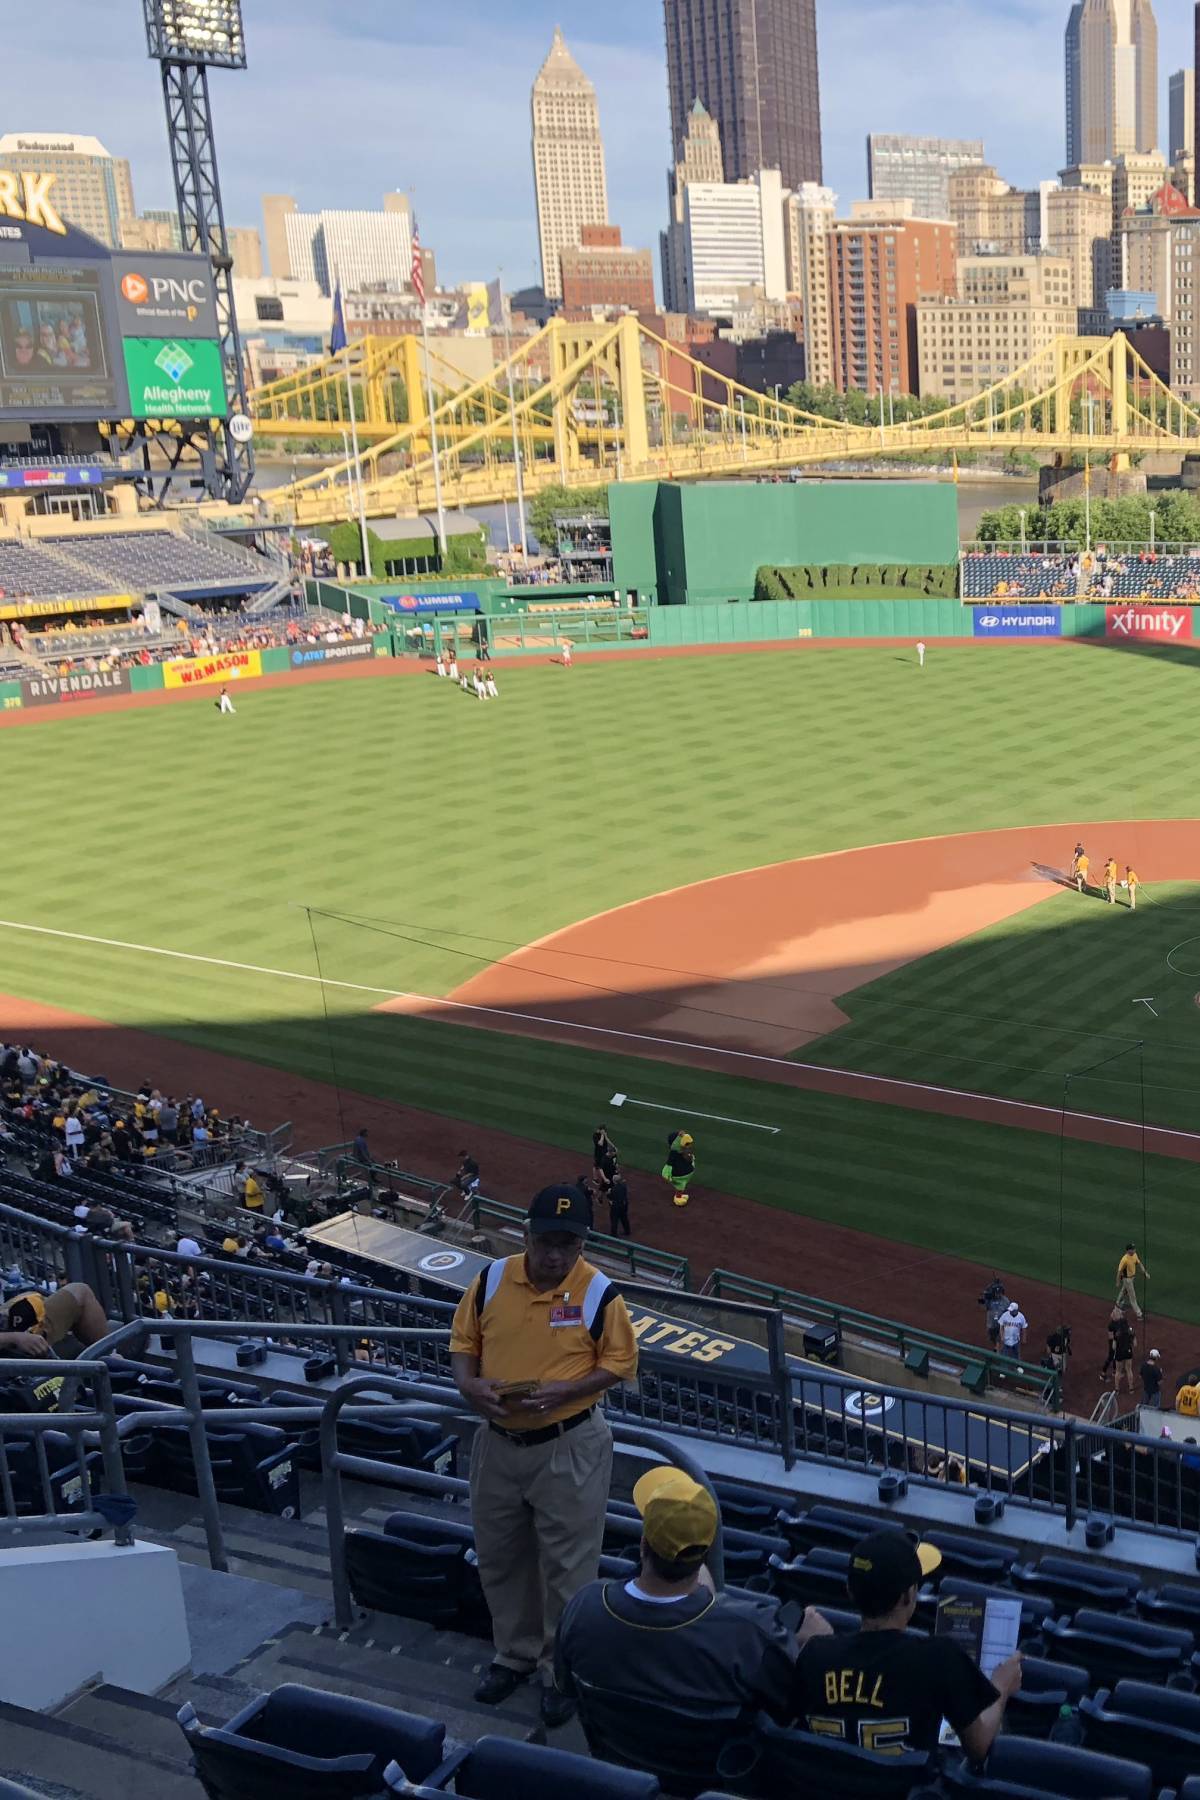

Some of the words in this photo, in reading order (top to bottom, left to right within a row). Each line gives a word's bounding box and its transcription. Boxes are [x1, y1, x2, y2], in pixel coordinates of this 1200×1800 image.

[151, 278, 207, 303] PNC
[143, 386, 211, 403] Allegheny
[145, 404, 174, 413] Health
[175, 404, 212, 414] Network
[418, 595, 462, 605] LUMBER
[1002, 616, 1055, 626] HYUNDAI
[1112, 609, 1186, 635] xfinity
[30, 670, 122, 696] RIVENDALE
[556, 1198, 571, 1215] P
[13, 1315, 23, 1327] P
[627, 1309, 736, 1362] ATES
[825, 1669, 884, 1708] BELL
